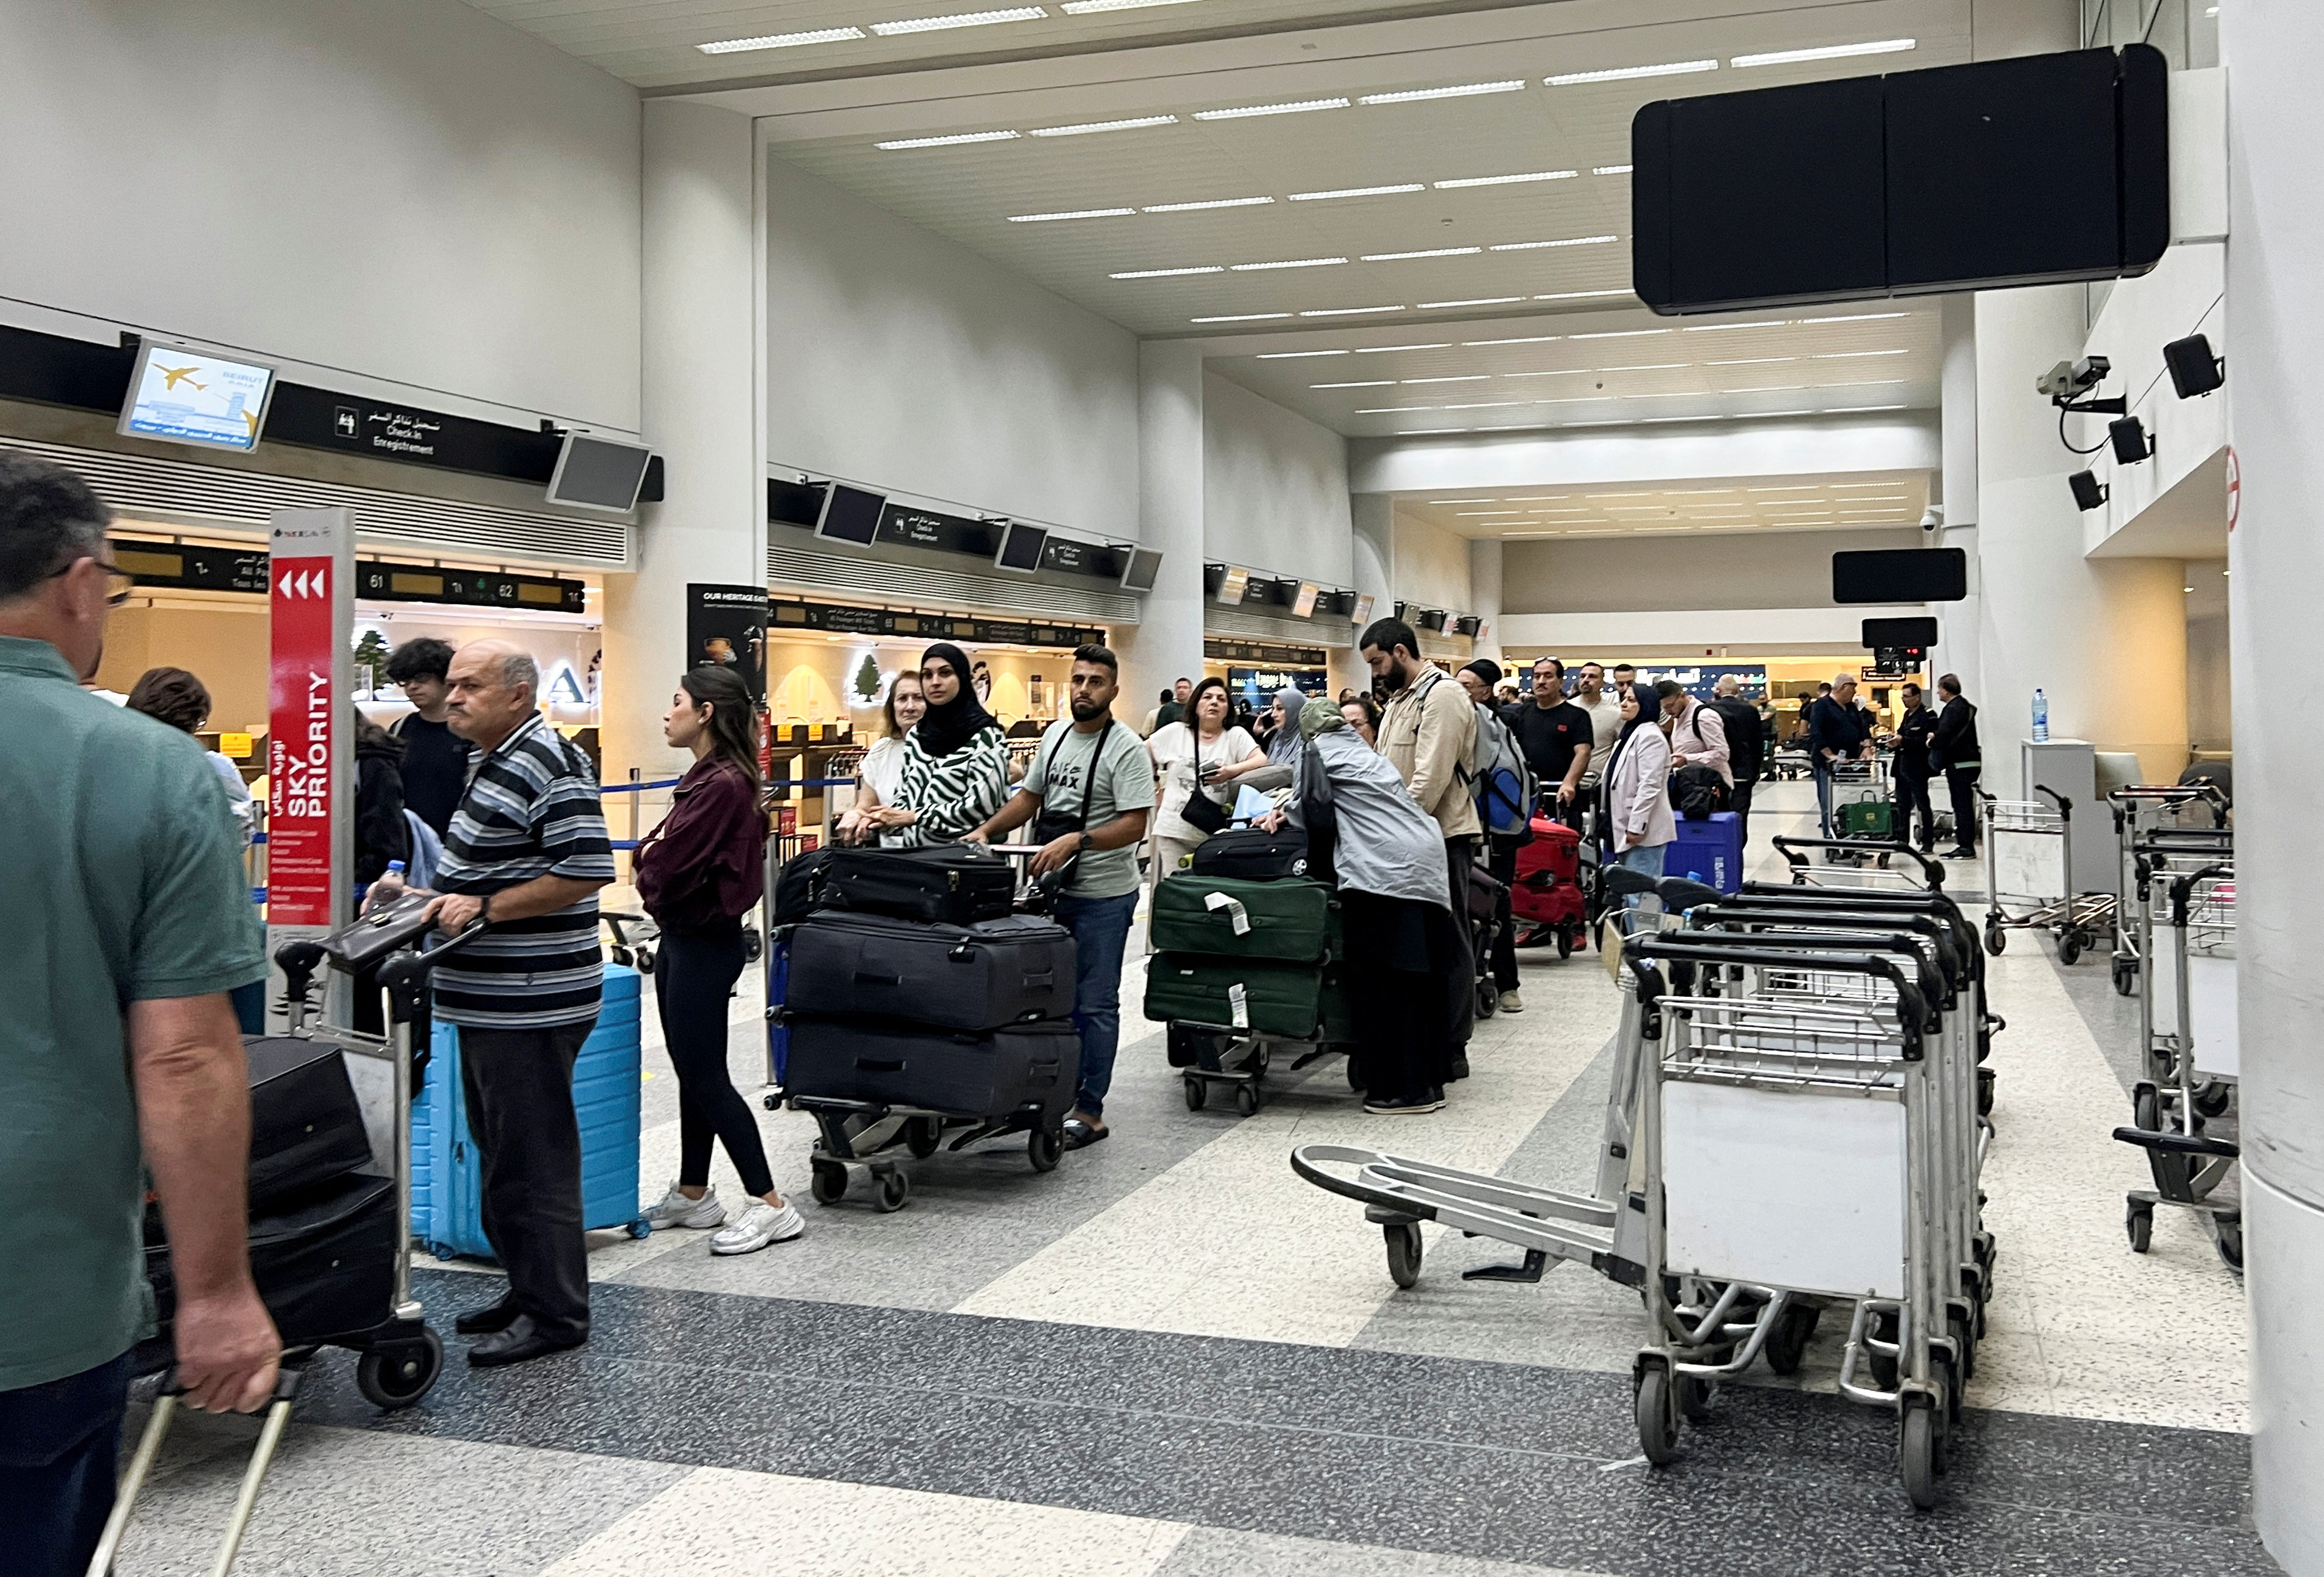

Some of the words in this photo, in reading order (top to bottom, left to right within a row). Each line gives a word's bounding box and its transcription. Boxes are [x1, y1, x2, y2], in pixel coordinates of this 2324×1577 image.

[223, 372, 264, 384] BEIRUT
[369, 574, 384, 589] 61
[499, 584, 513, 597] 62
[308, 671, 328, 817] PRIORITY
[288, 755, 308, 817] SKY
[1048, 774, 1080, 790] MAX
